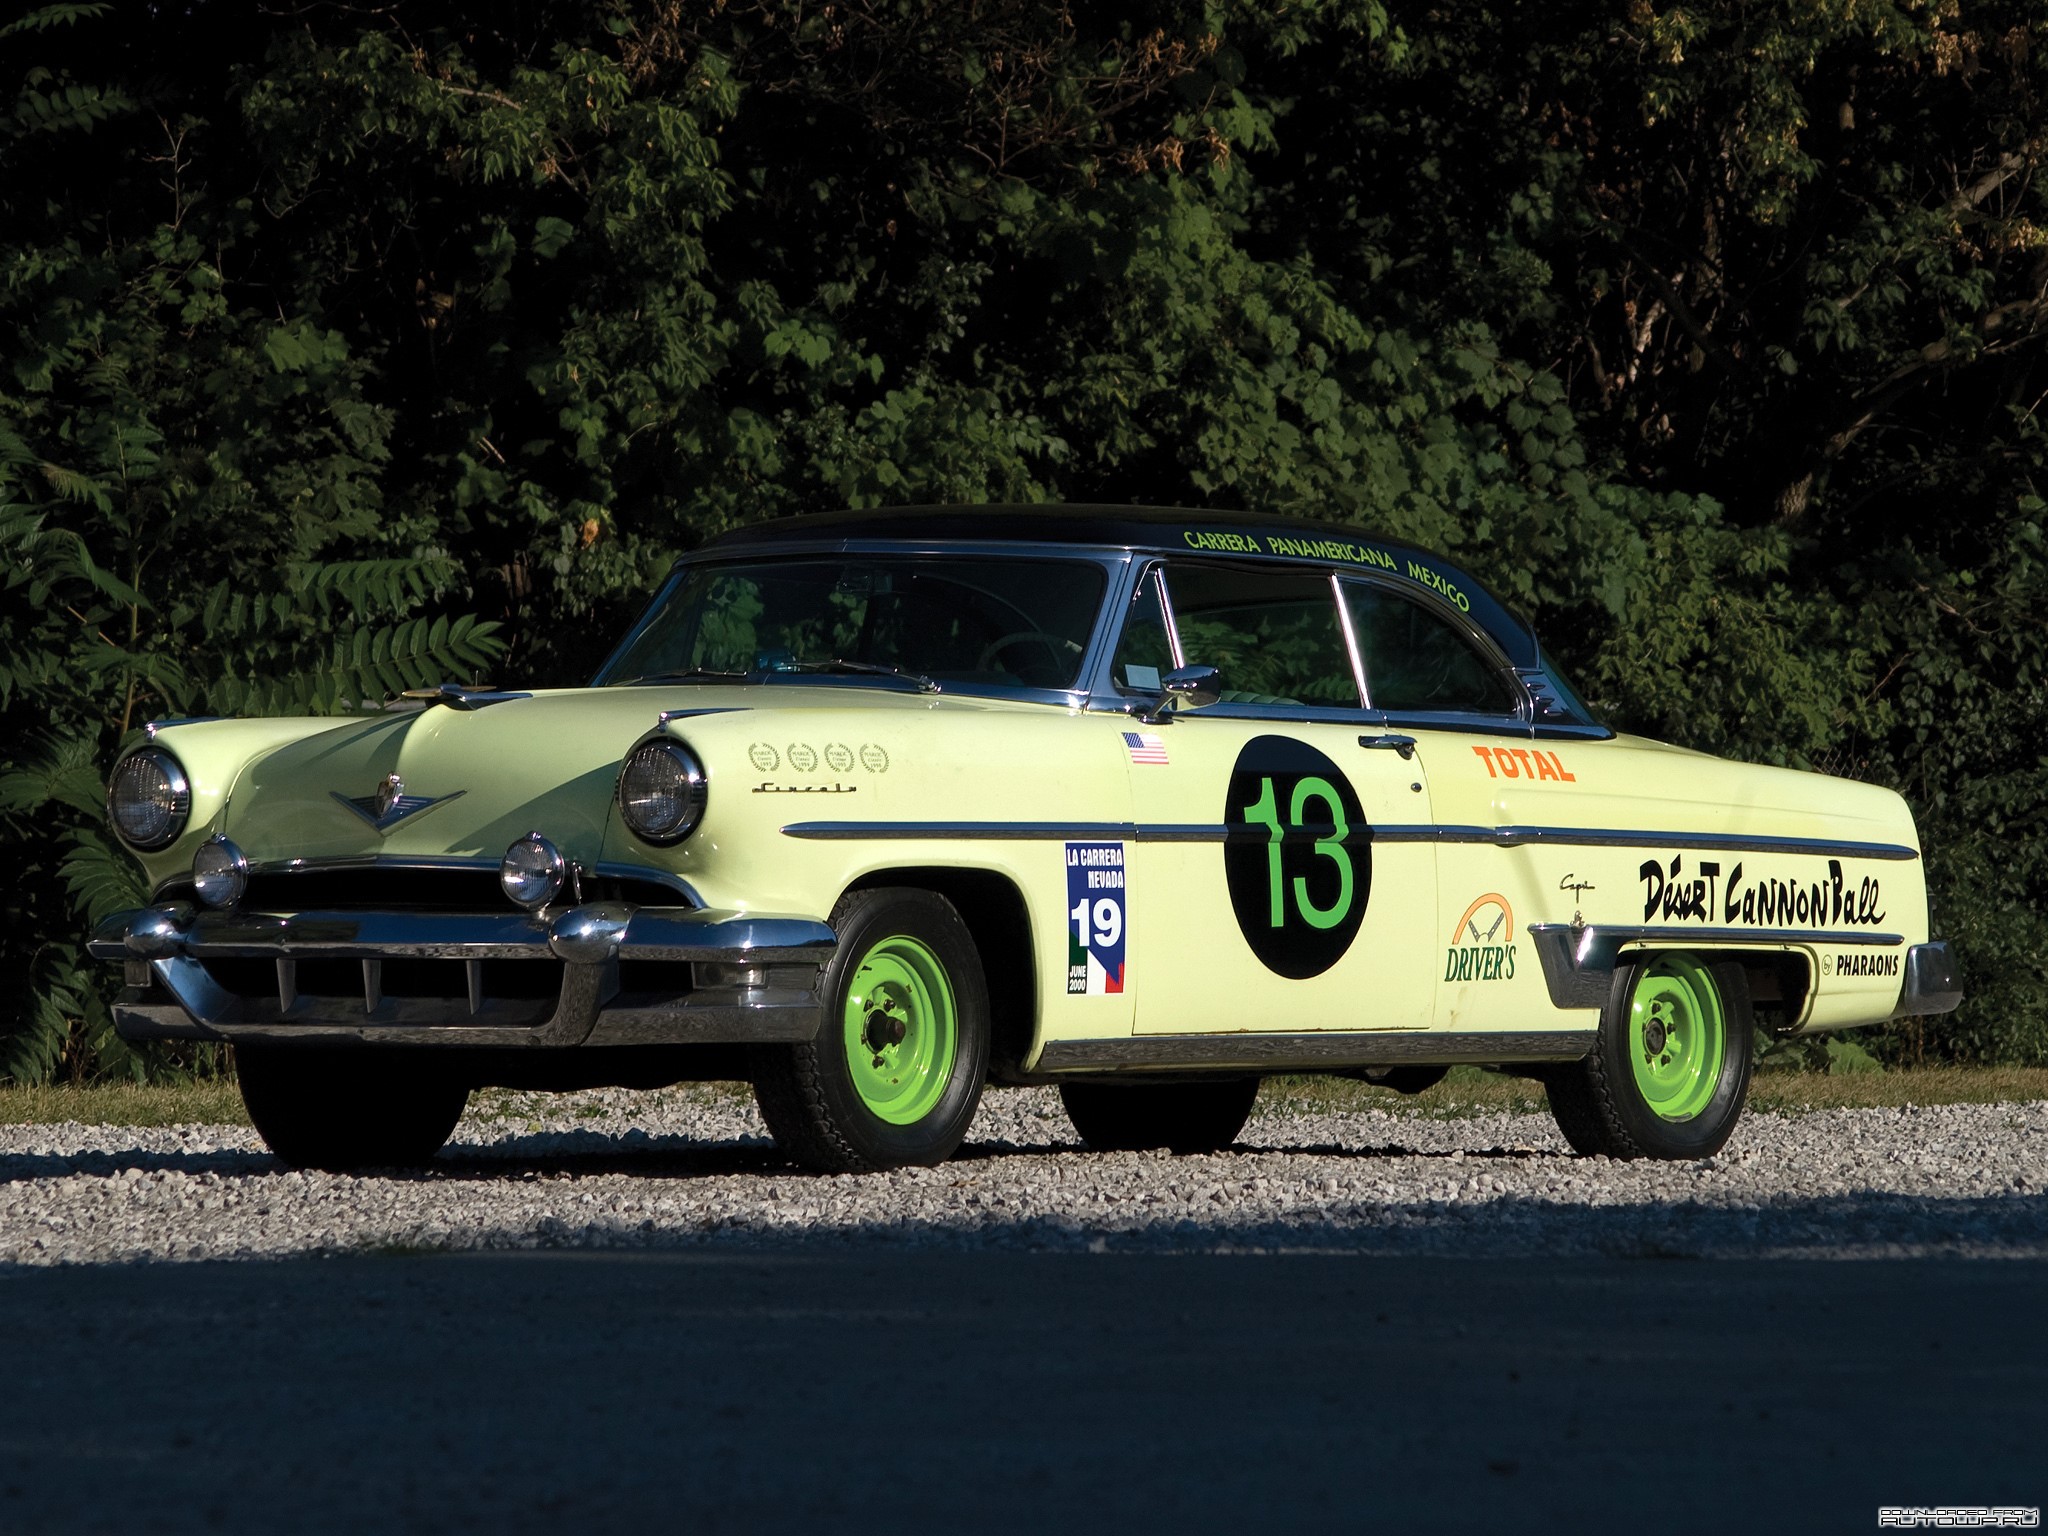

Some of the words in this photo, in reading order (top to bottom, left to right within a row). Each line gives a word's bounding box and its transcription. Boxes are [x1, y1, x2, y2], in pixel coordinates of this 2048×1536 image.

[1183, 531, 1261, 552] CARRERA
[1266, 536, 1397, 571] PANAMERICANA
[1407, 560, 1470, 613] MEXICO
[1471, 746, 1576, 782] TOTAL
[1067, 848, 1079, 866] LA
[1080, 848, 1123, 866] CARRERA
[1243, 777, 1353, 929] 13
[1087, 870, 1124, 889] NEVADA
[1559, 873, 1595, 904] Capri
[1071, 898, 1122, 948] 19
[1069, 965, 1087, 978] JUNE
[1444, 944, 1517, 982] DRIVER'S
[1836, 955, 1899, 976] PHARAONS
[1068, 978, 1086, 991] 2000
